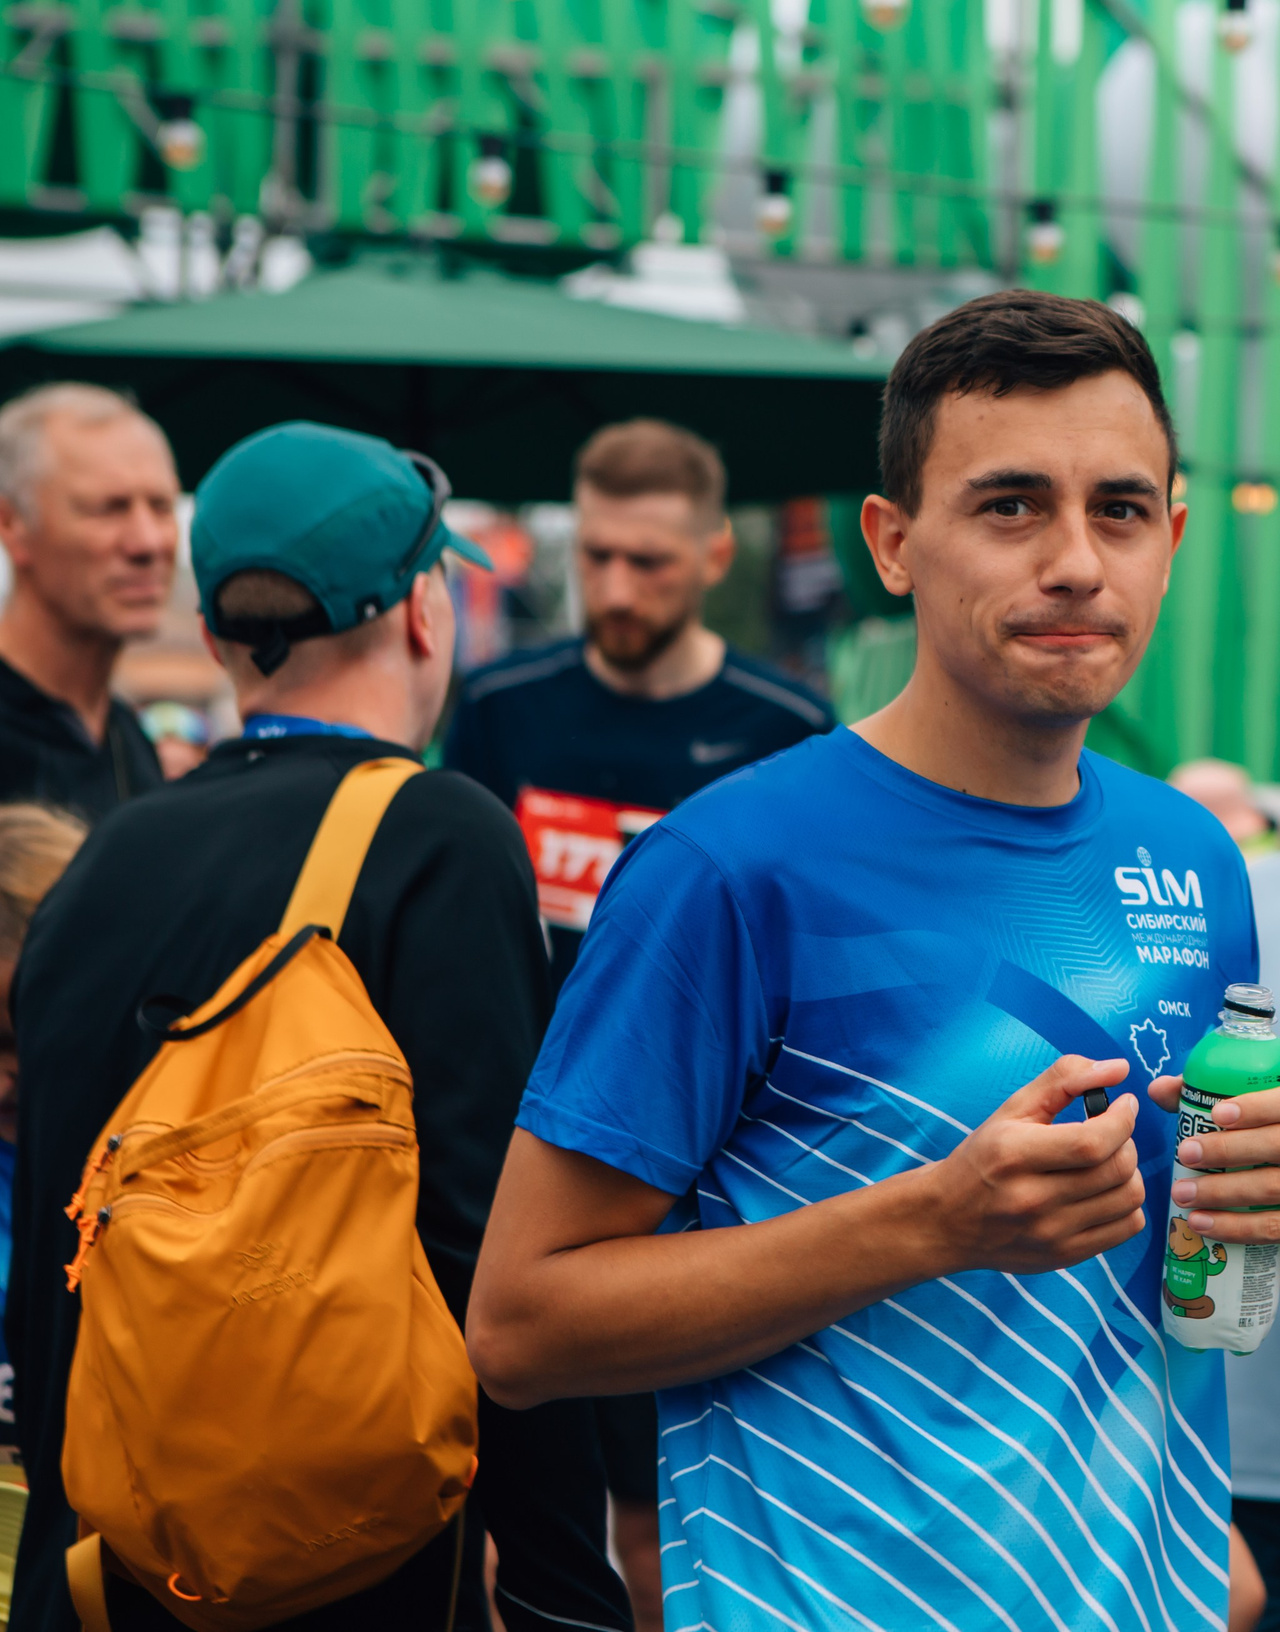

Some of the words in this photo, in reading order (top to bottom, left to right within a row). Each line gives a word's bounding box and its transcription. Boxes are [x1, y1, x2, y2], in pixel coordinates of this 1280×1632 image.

[1126, 912, 1207, 933] СИБИРСКИЙ
[1136, 945, 1210, 970] МАРАФОН
[1158, 999, 1192, 1018] ОМСК
